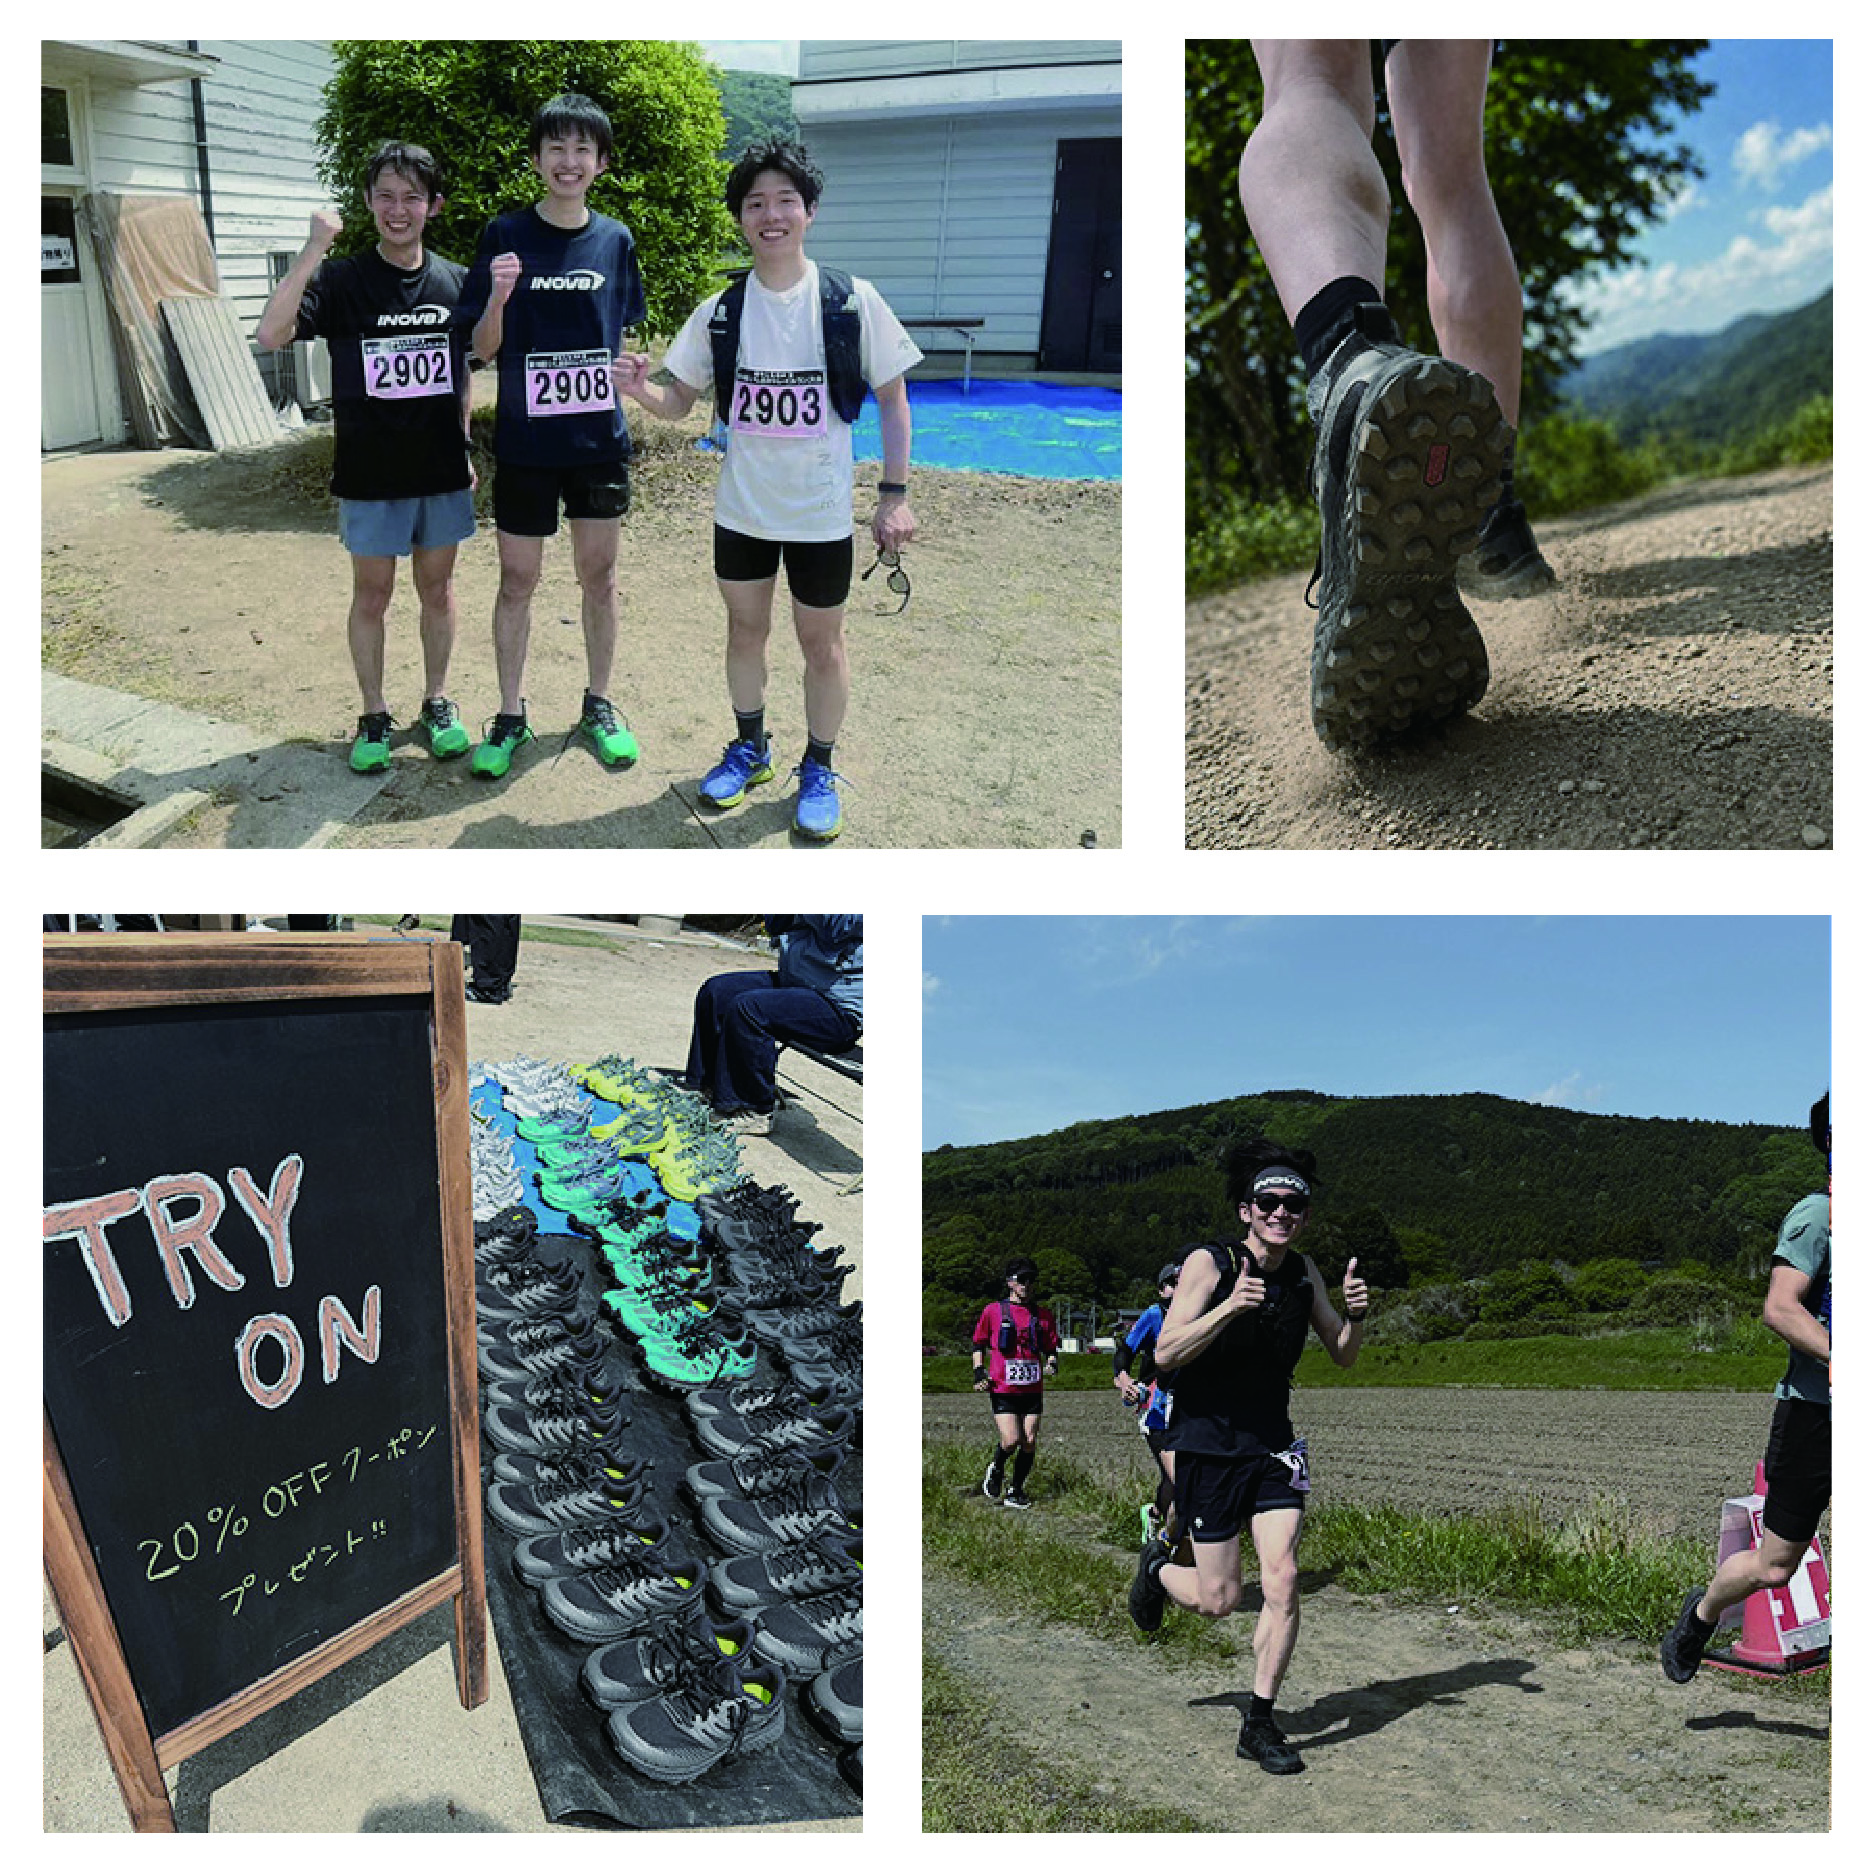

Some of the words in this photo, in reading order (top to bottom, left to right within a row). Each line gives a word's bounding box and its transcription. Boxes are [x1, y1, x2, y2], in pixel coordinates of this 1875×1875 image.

[373, 351, 447, 389] 2902
[535, 368, 610, 404] 2908
[738, 385, 822, 426] 2903
[43, 1152, 305, 1329] TRY
[235, 1285, 382, 1410] ON
[137, 1504, 249, 1582] 20%
[262, 1470, 332, 1518] OFF
[341, 1424, 438, 1483] クーポン
